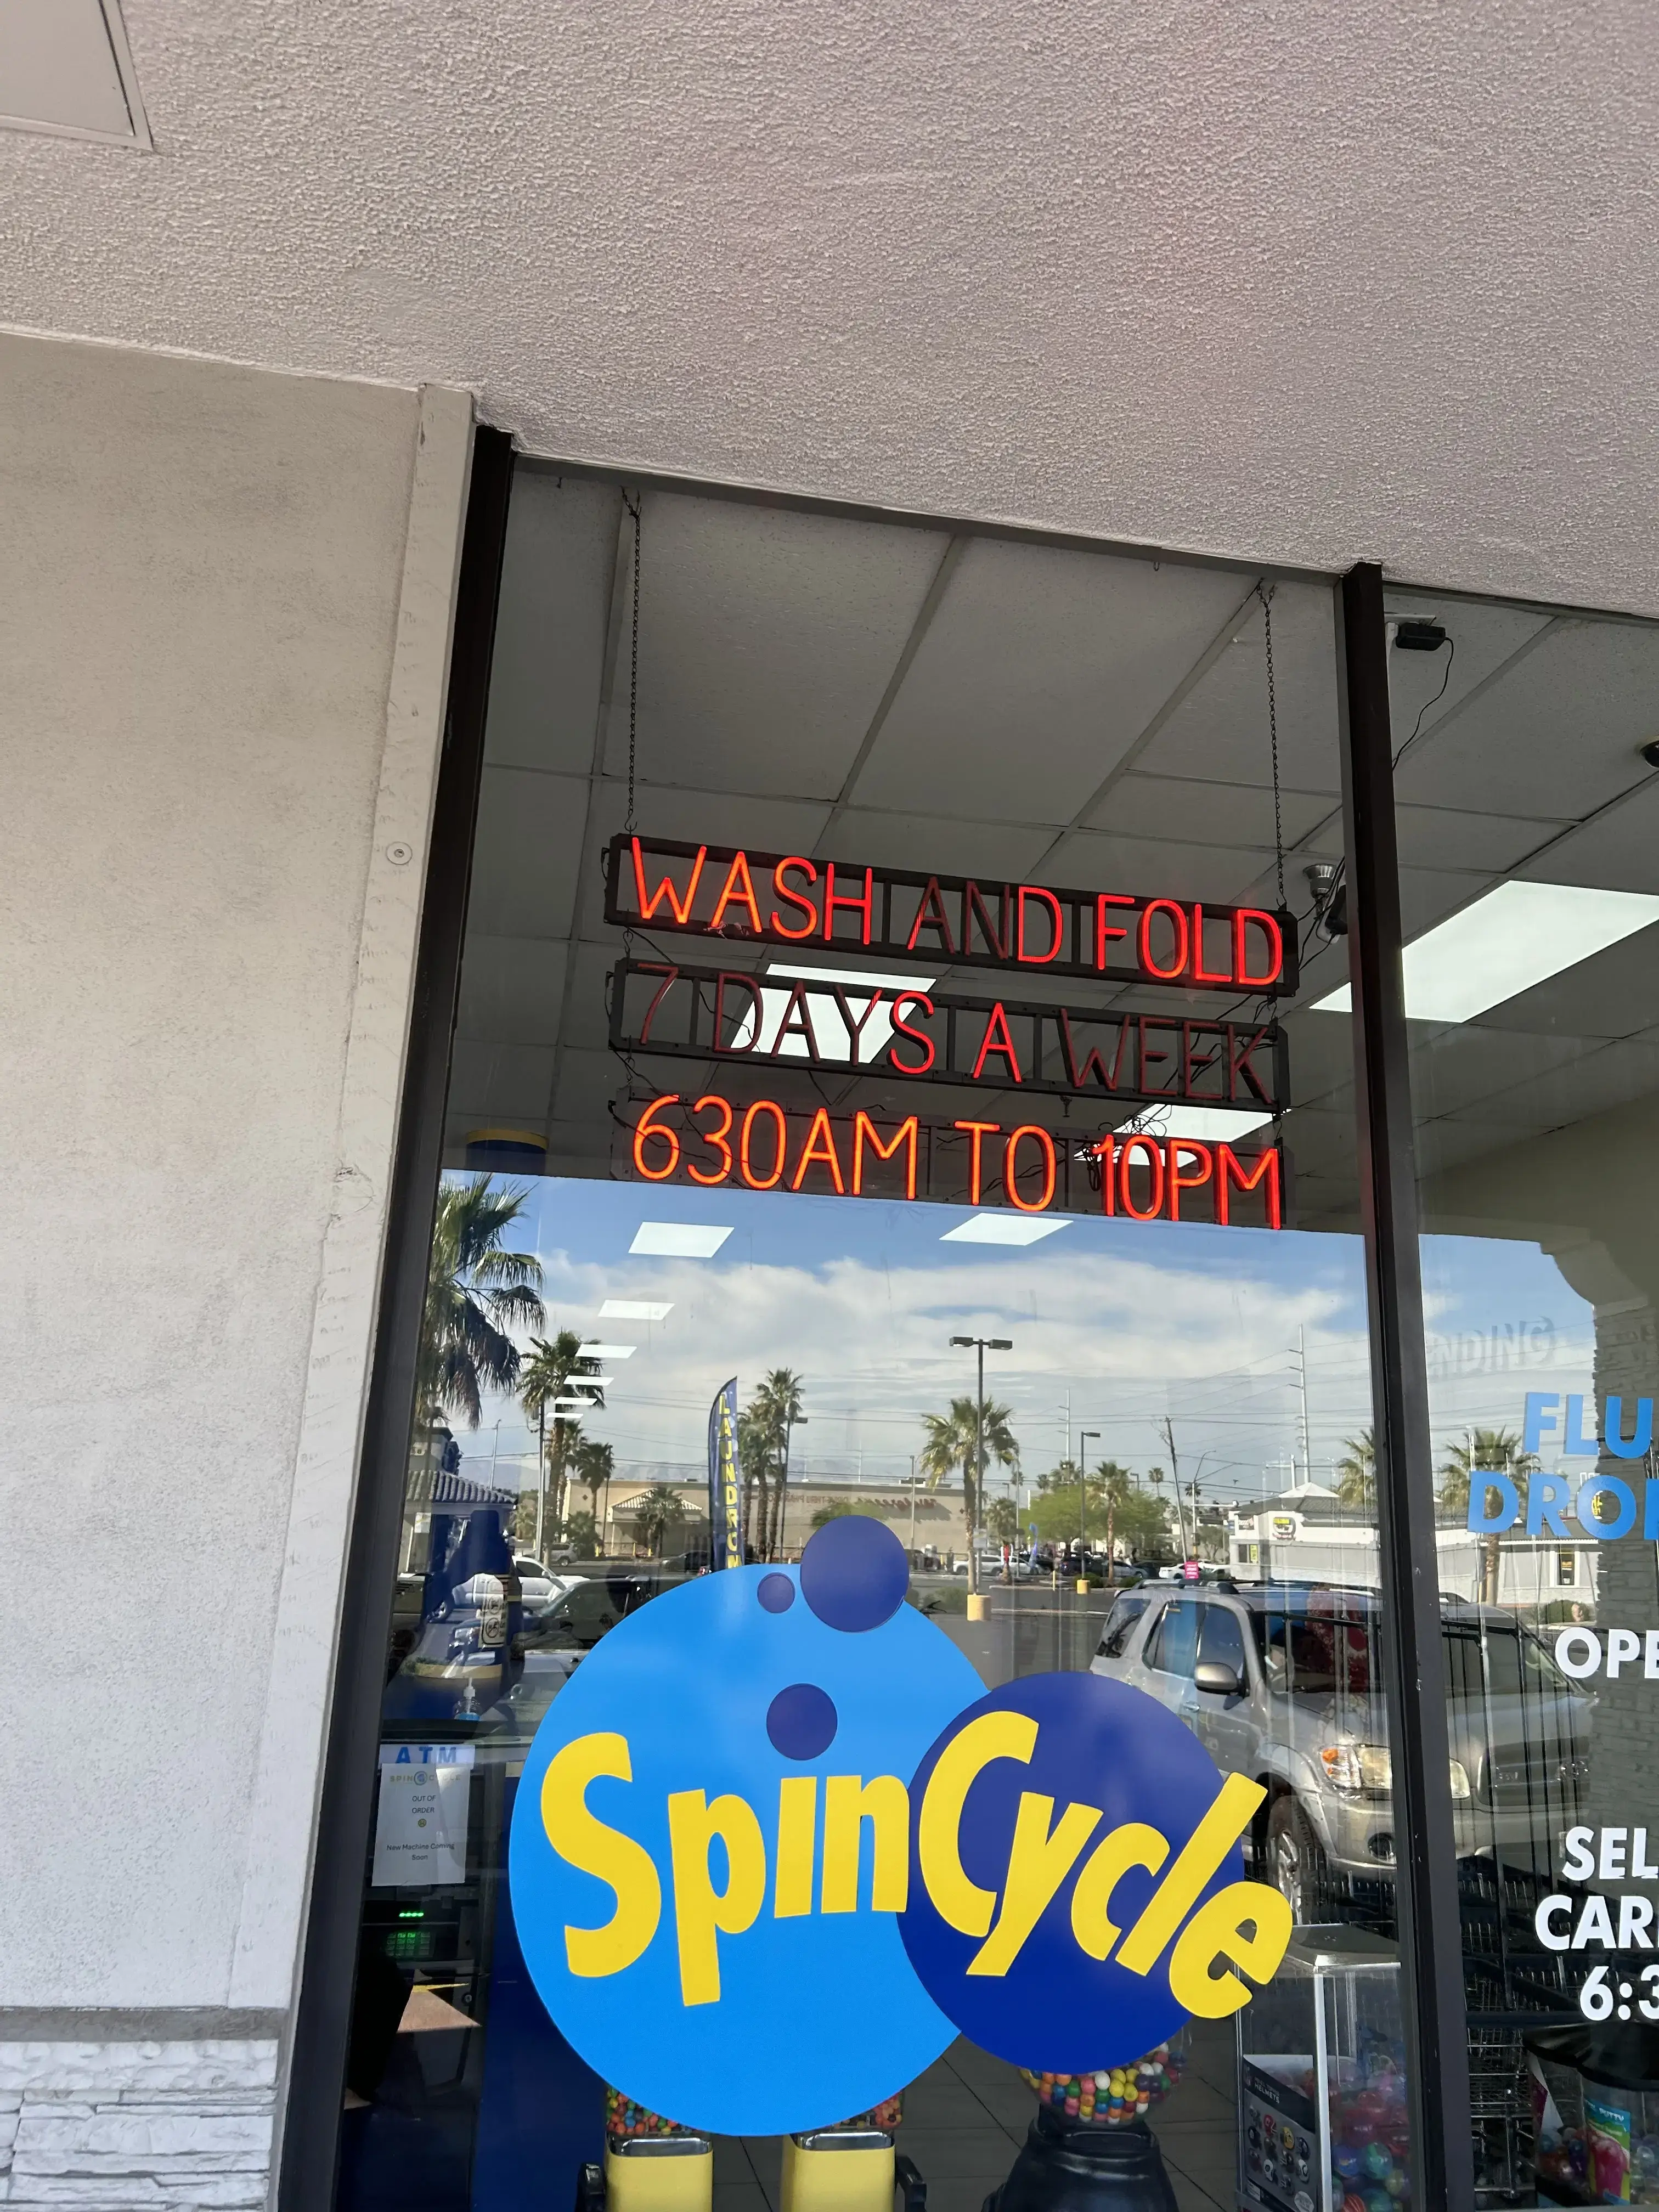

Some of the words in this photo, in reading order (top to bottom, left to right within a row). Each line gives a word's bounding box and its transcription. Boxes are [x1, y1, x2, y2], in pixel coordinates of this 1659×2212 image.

[631, 836, 873, 946] WASH
[906, 878, 1063, 963] AND
[1096, 893, 1284, 986] FOLD
[637, 963, 679, 1045] 7
[713, 973, 936, 1075] DAYS
[972, 1001, 1023, 1084] A
[1058, 1007, 1274, 1105] WEEK
[953, 1120, 1057, 1213] TO
[1091, 1133, 1282, 1231] 10PM
[395, 1746, 456, 1764] ATM
